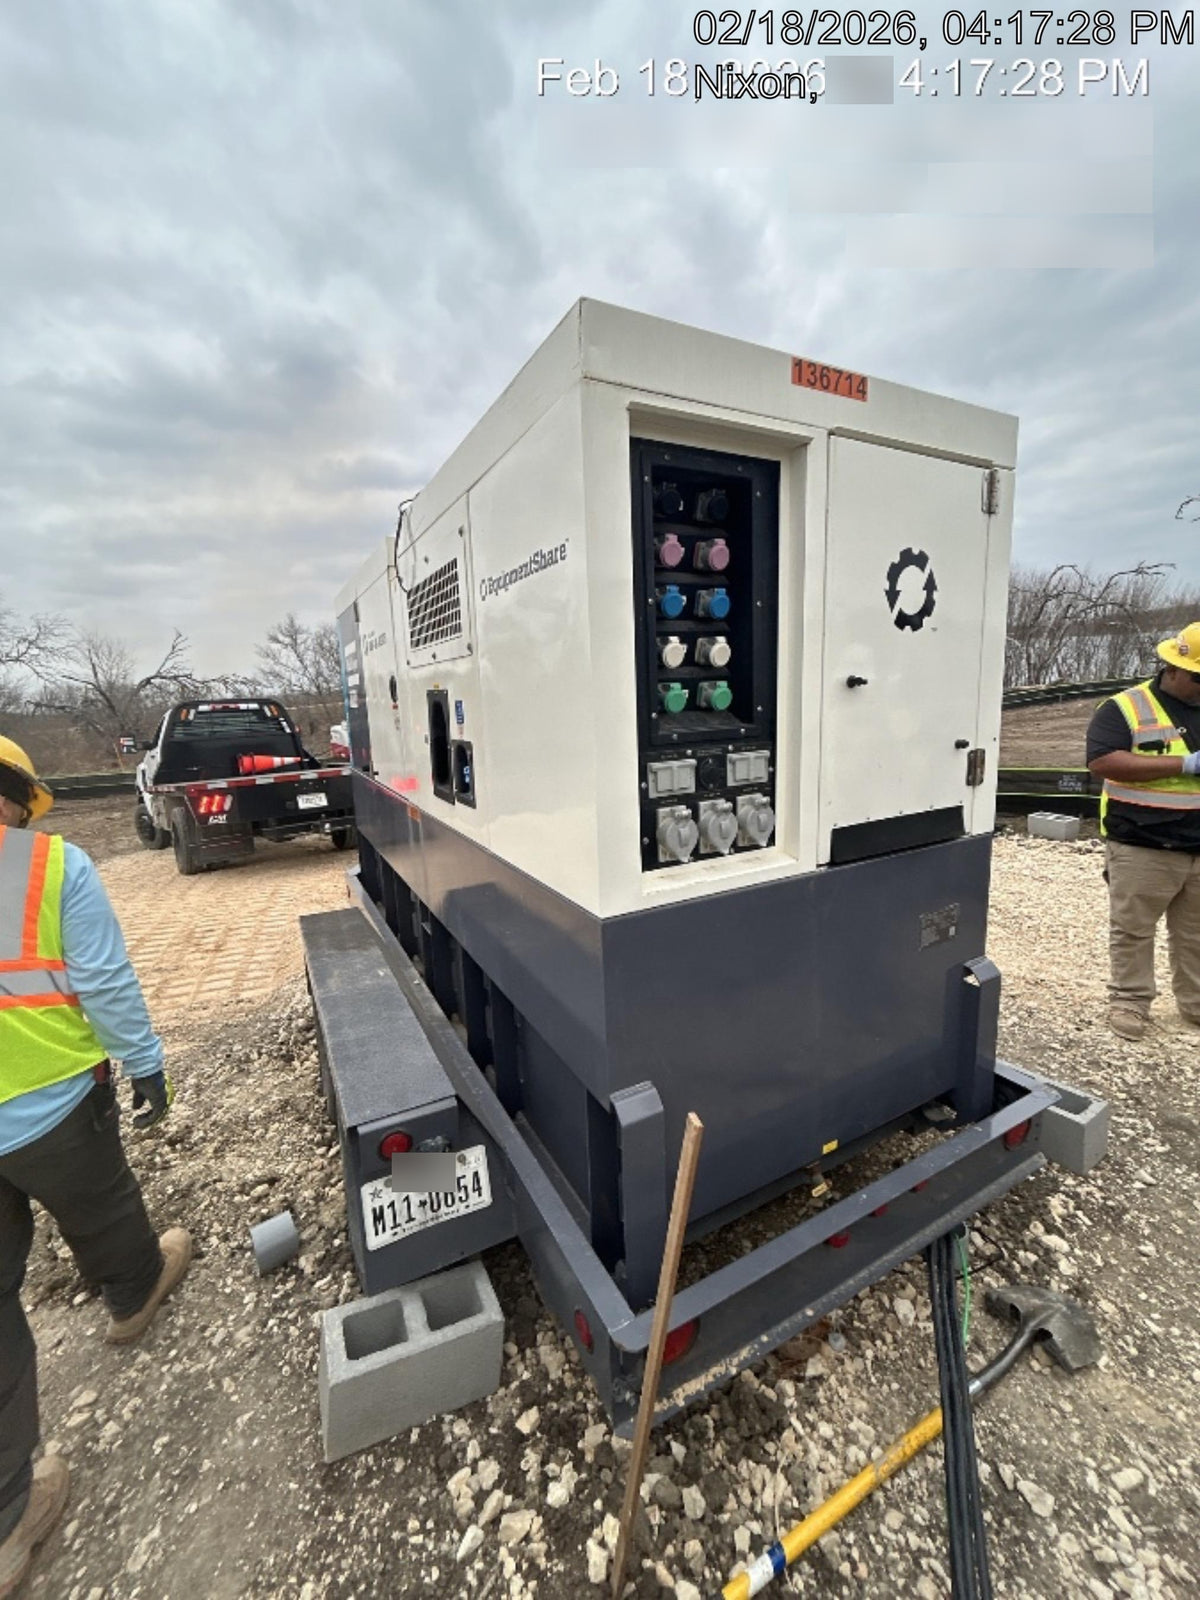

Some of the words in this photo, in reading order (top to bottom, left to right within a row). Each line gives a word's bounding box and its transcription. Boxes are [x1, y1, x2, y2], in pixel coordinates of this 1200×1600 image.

[795, 359, 867, 400] 136714
[487, 543, 567, 597] EquipmentShare
[371, 1194, 416, 1237] M11
